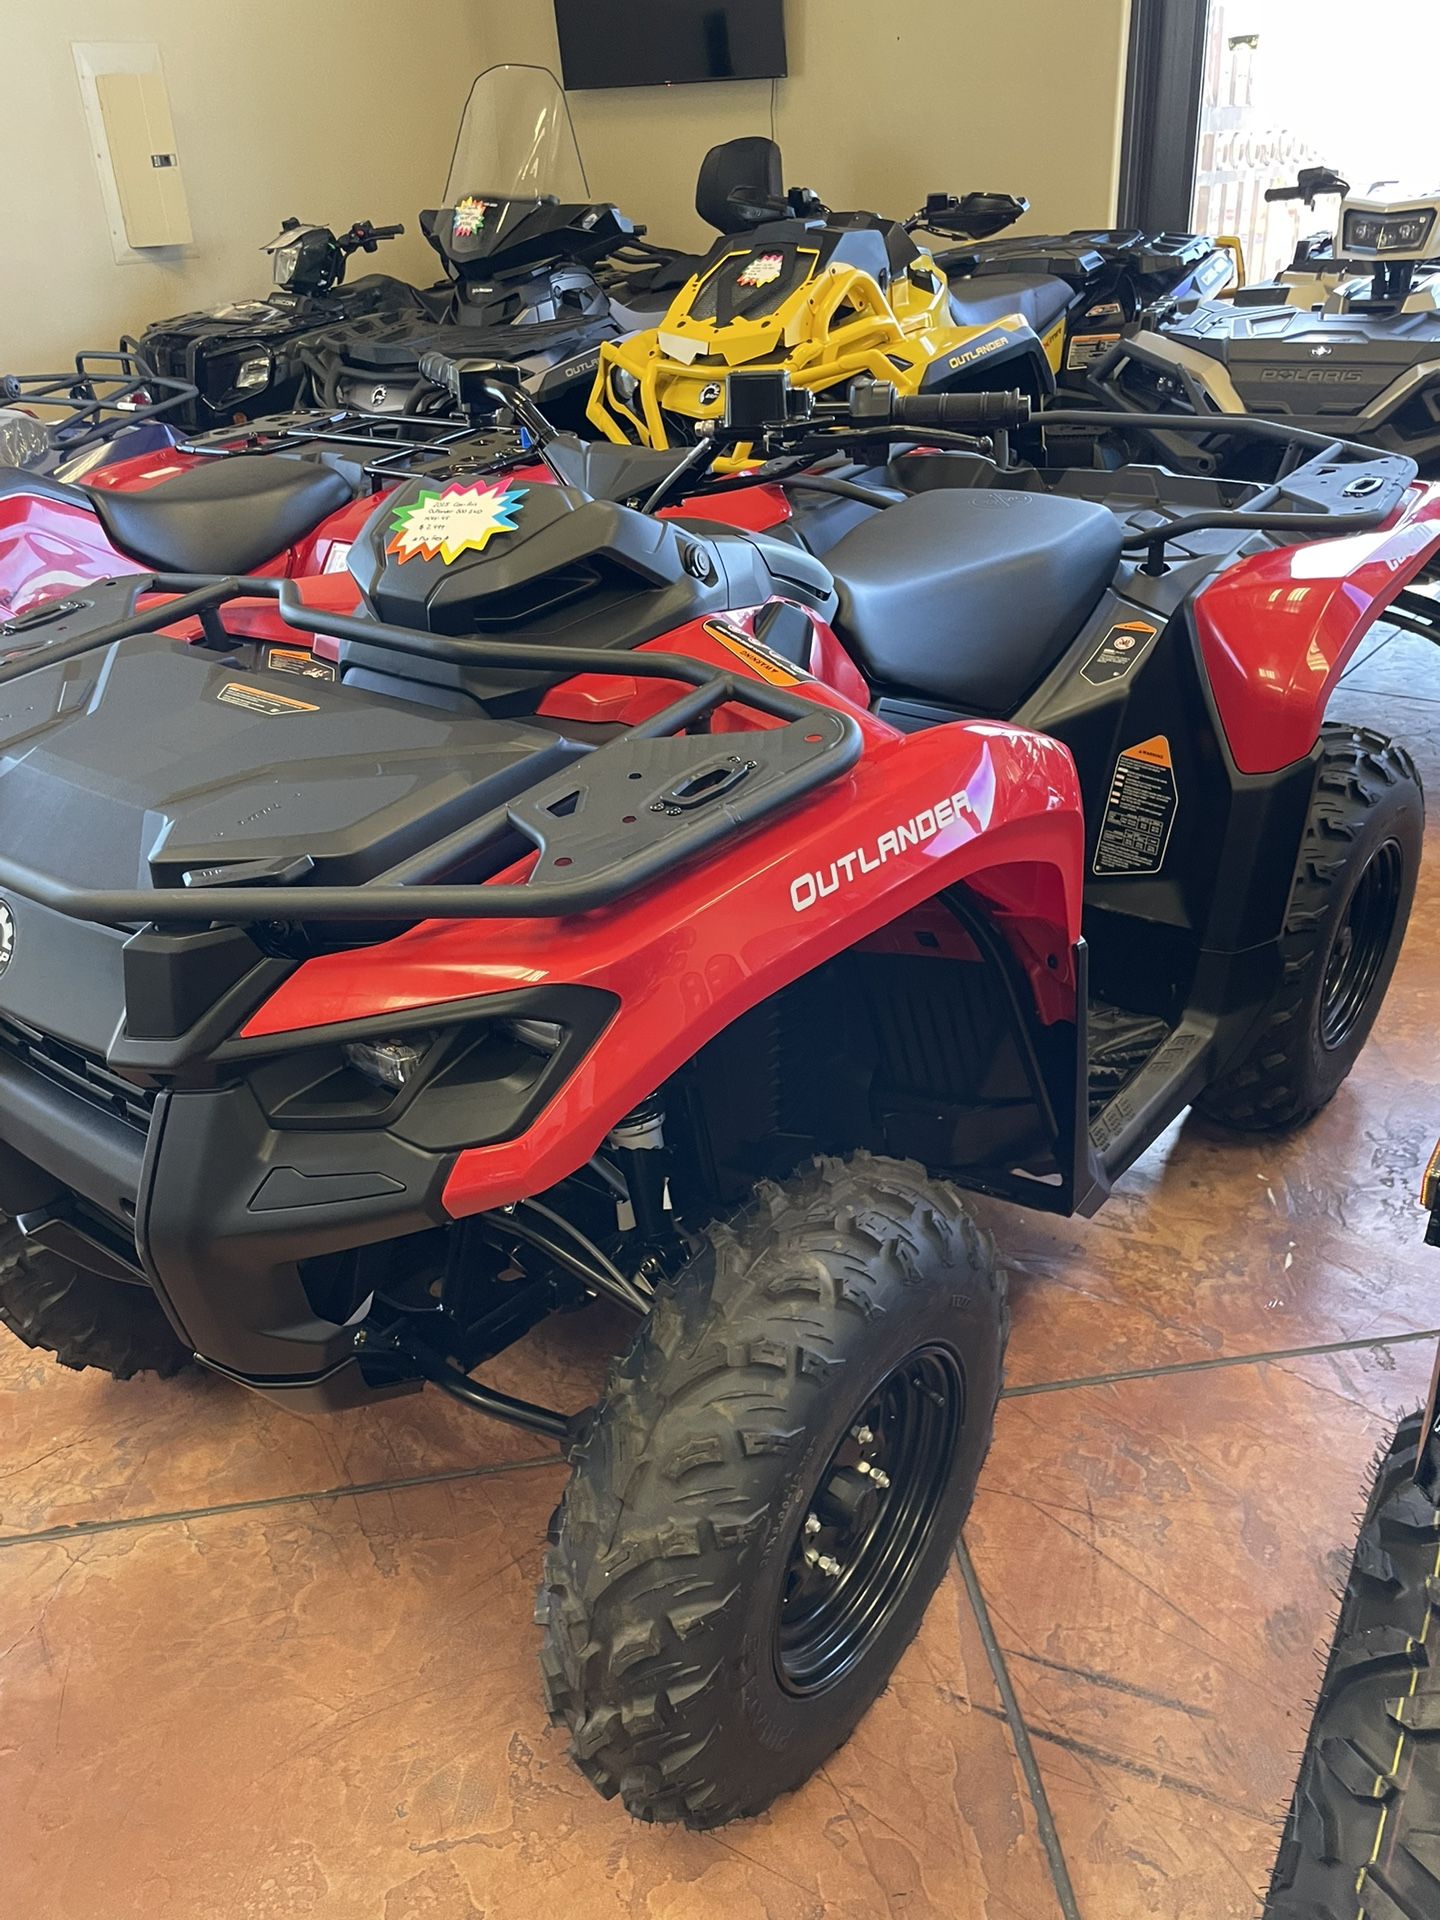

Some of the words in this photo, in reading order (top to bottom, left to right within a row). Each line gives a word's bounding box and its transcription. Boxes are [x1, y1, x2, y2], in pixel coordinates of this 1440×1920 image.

[949, 336, 1009, 369] OUTLANDER
[565, 358, 599, 377] OUTLA
[1261, 368, 1363, 382] POLARIS
[789, 789, 973, 913] OUTLANDER
